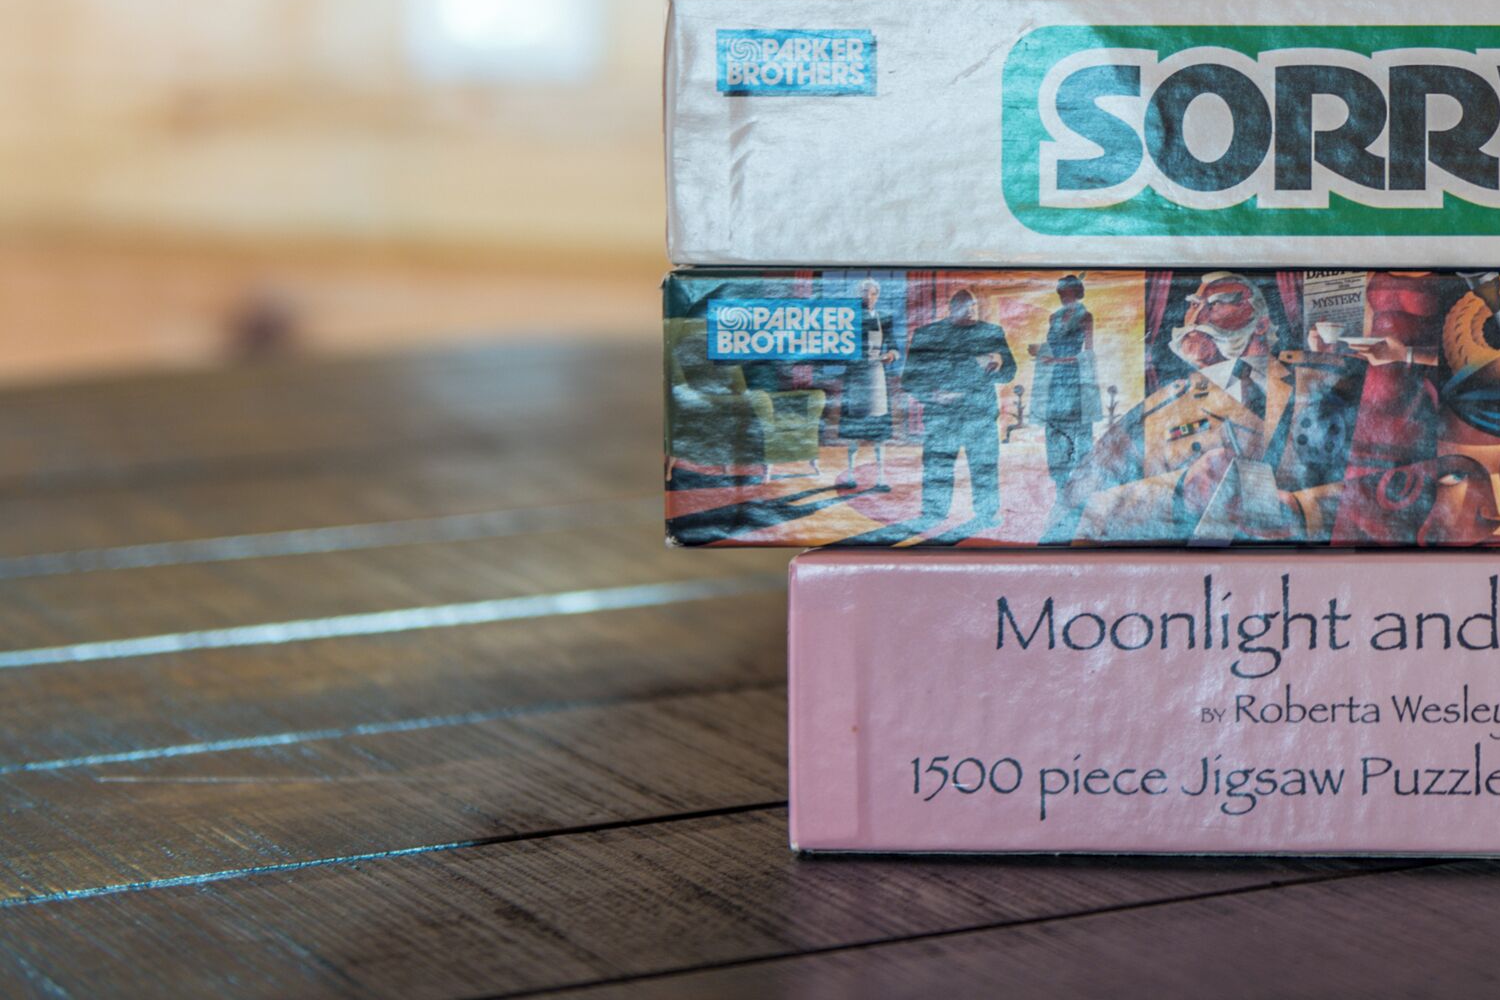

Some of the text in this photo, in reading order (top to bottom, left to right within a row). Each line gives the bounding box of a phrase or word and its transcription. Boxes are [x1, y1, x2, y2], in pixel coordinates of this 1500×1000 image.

[763, 39, 864, 62] PARKER
[727, 62, 866, 85] BROTHERS
[752, 306, 855, 331] PARKER
[717, 330, 856, 356] BROTHERS
[996, 573, 1351, 679] Moonlight
[1370, 574, 1499, 651] and
[1201, 707, 1226, 724] BY
[1235, 684, 1380, 724] Roberta
[911, 755, 1024, 801] 1500
[1040, 753, 1168, 820] piece
[1180, 753, 1345, 816] Jigsaw
